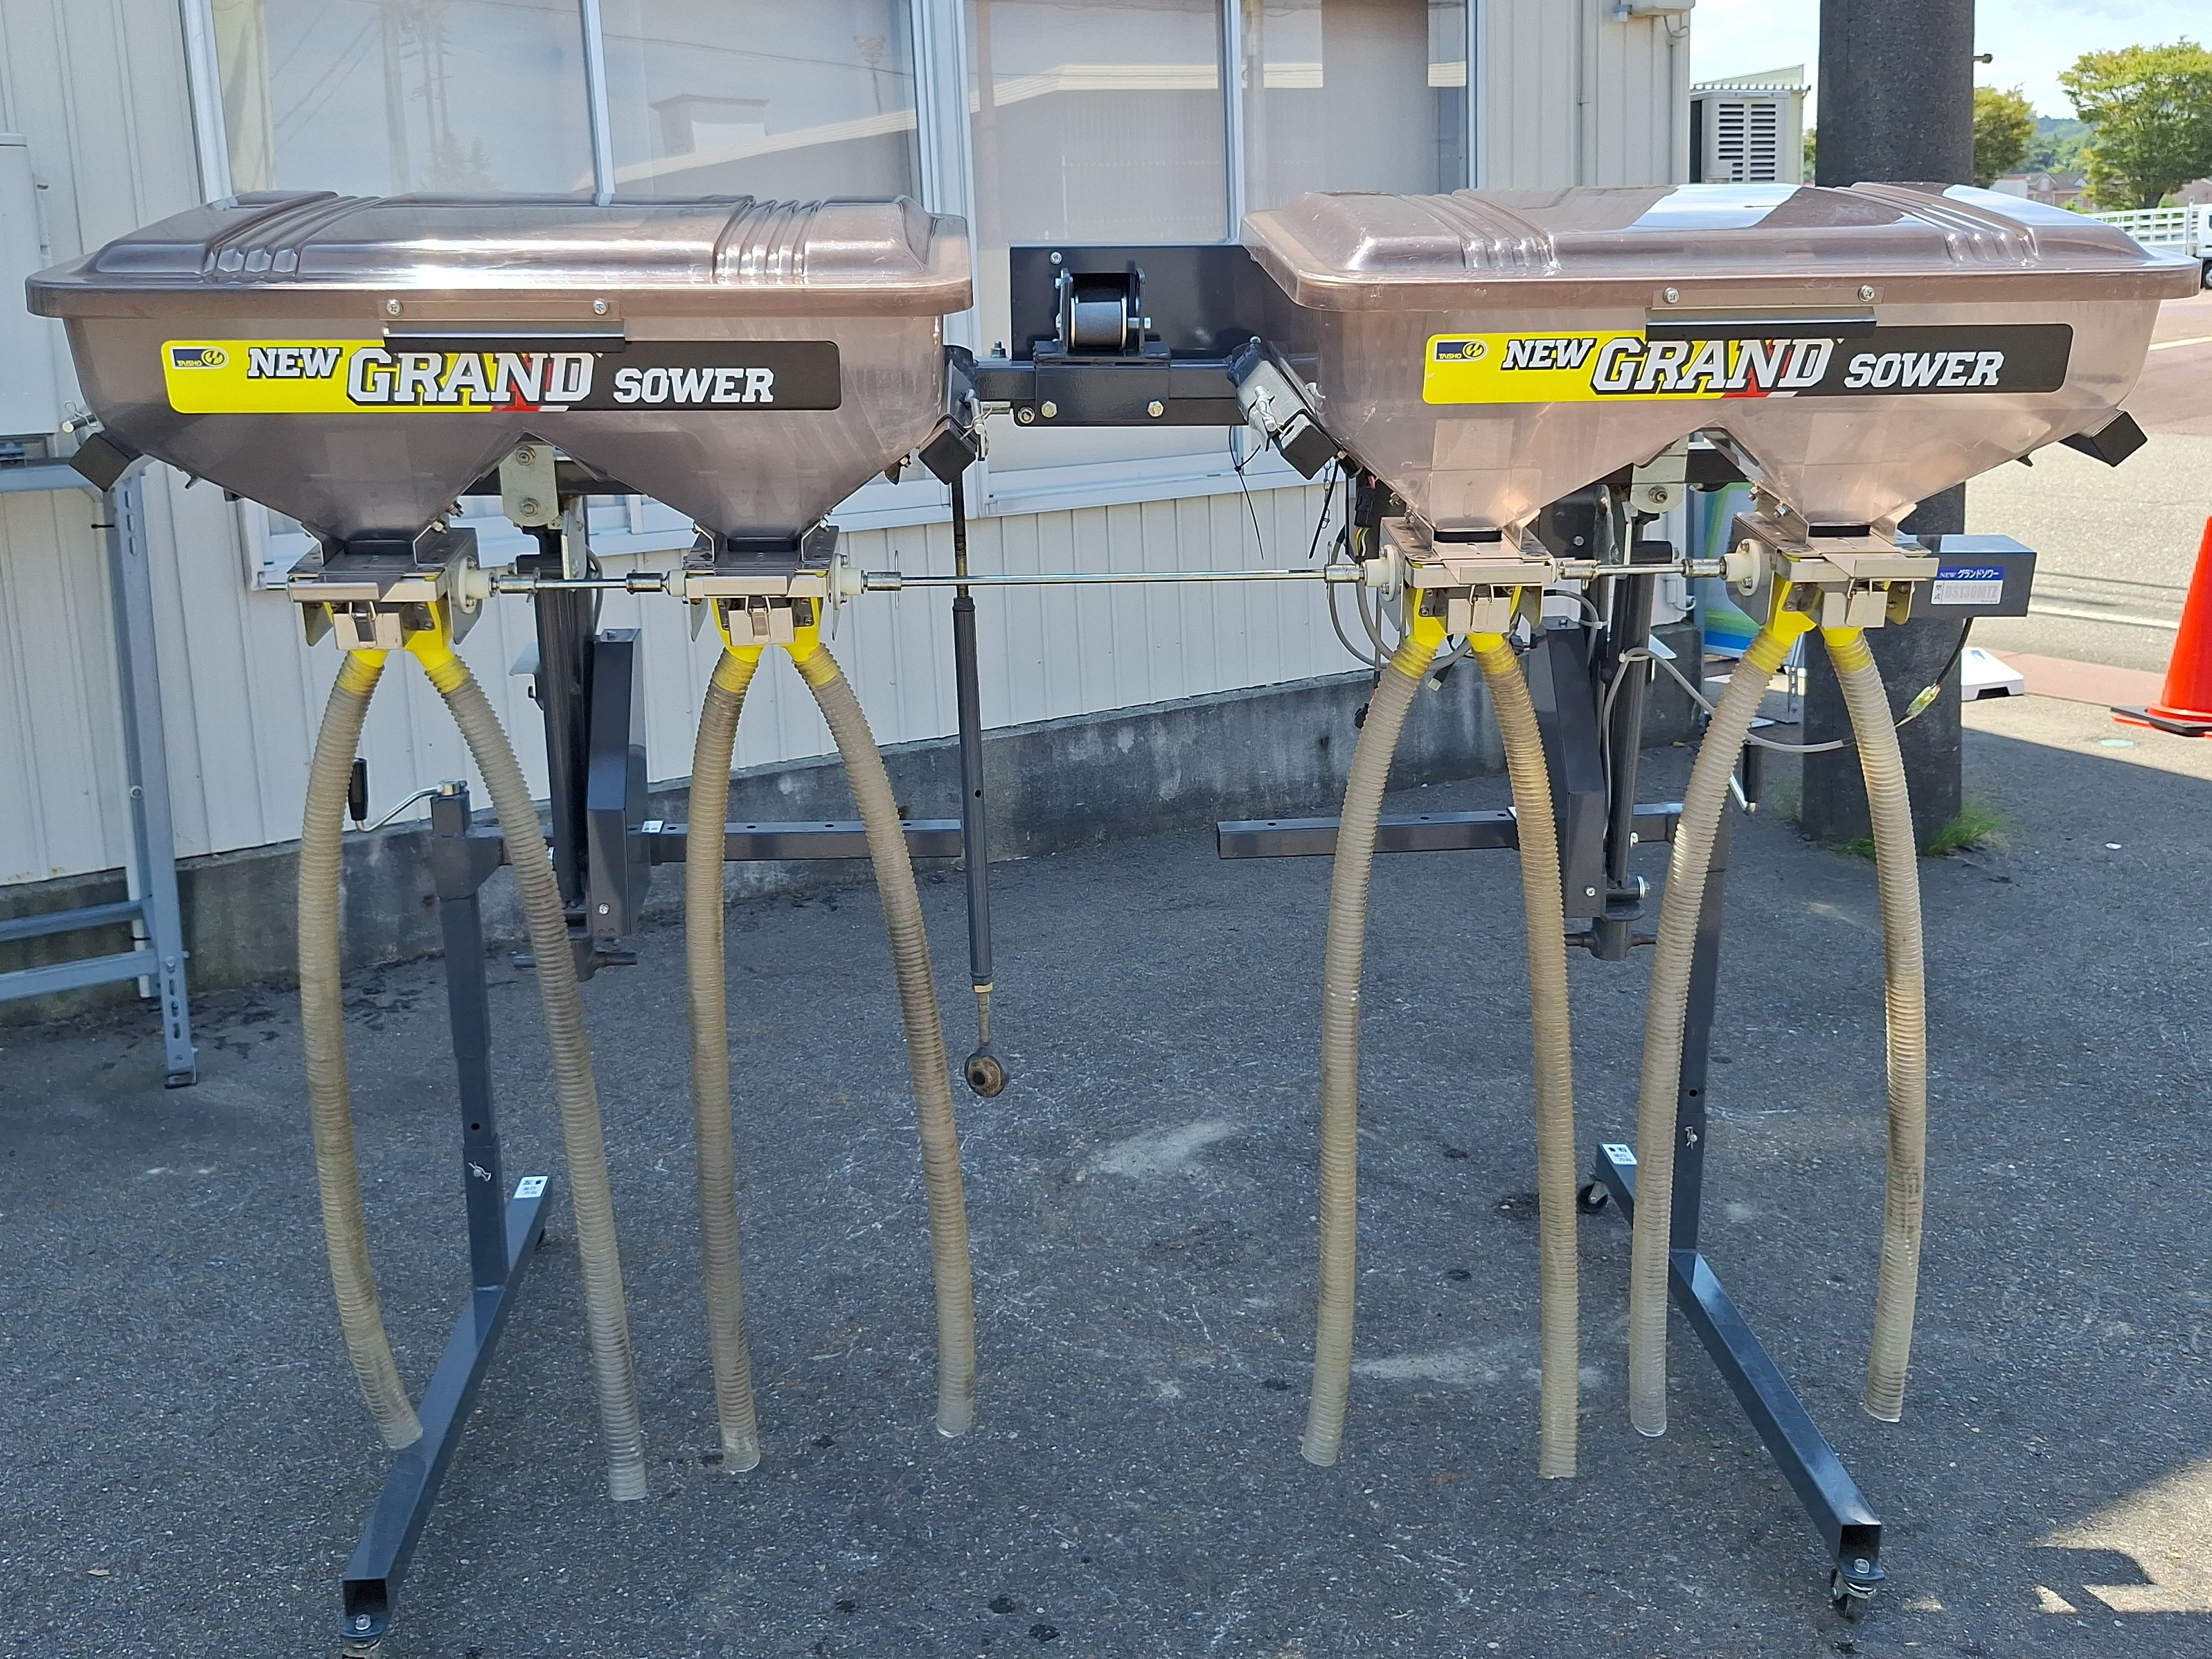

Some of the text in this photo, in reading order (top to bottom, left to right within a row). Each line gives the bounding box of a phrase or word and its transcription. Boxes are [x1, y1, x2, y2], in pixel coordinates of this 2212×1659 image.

[247, 347, 775, 404] NEW GRAND SOWER
[1501, 337, 2005, 391] NEW GRAND SOWER
[1957, 569, 1999, 579] グランドソワー
